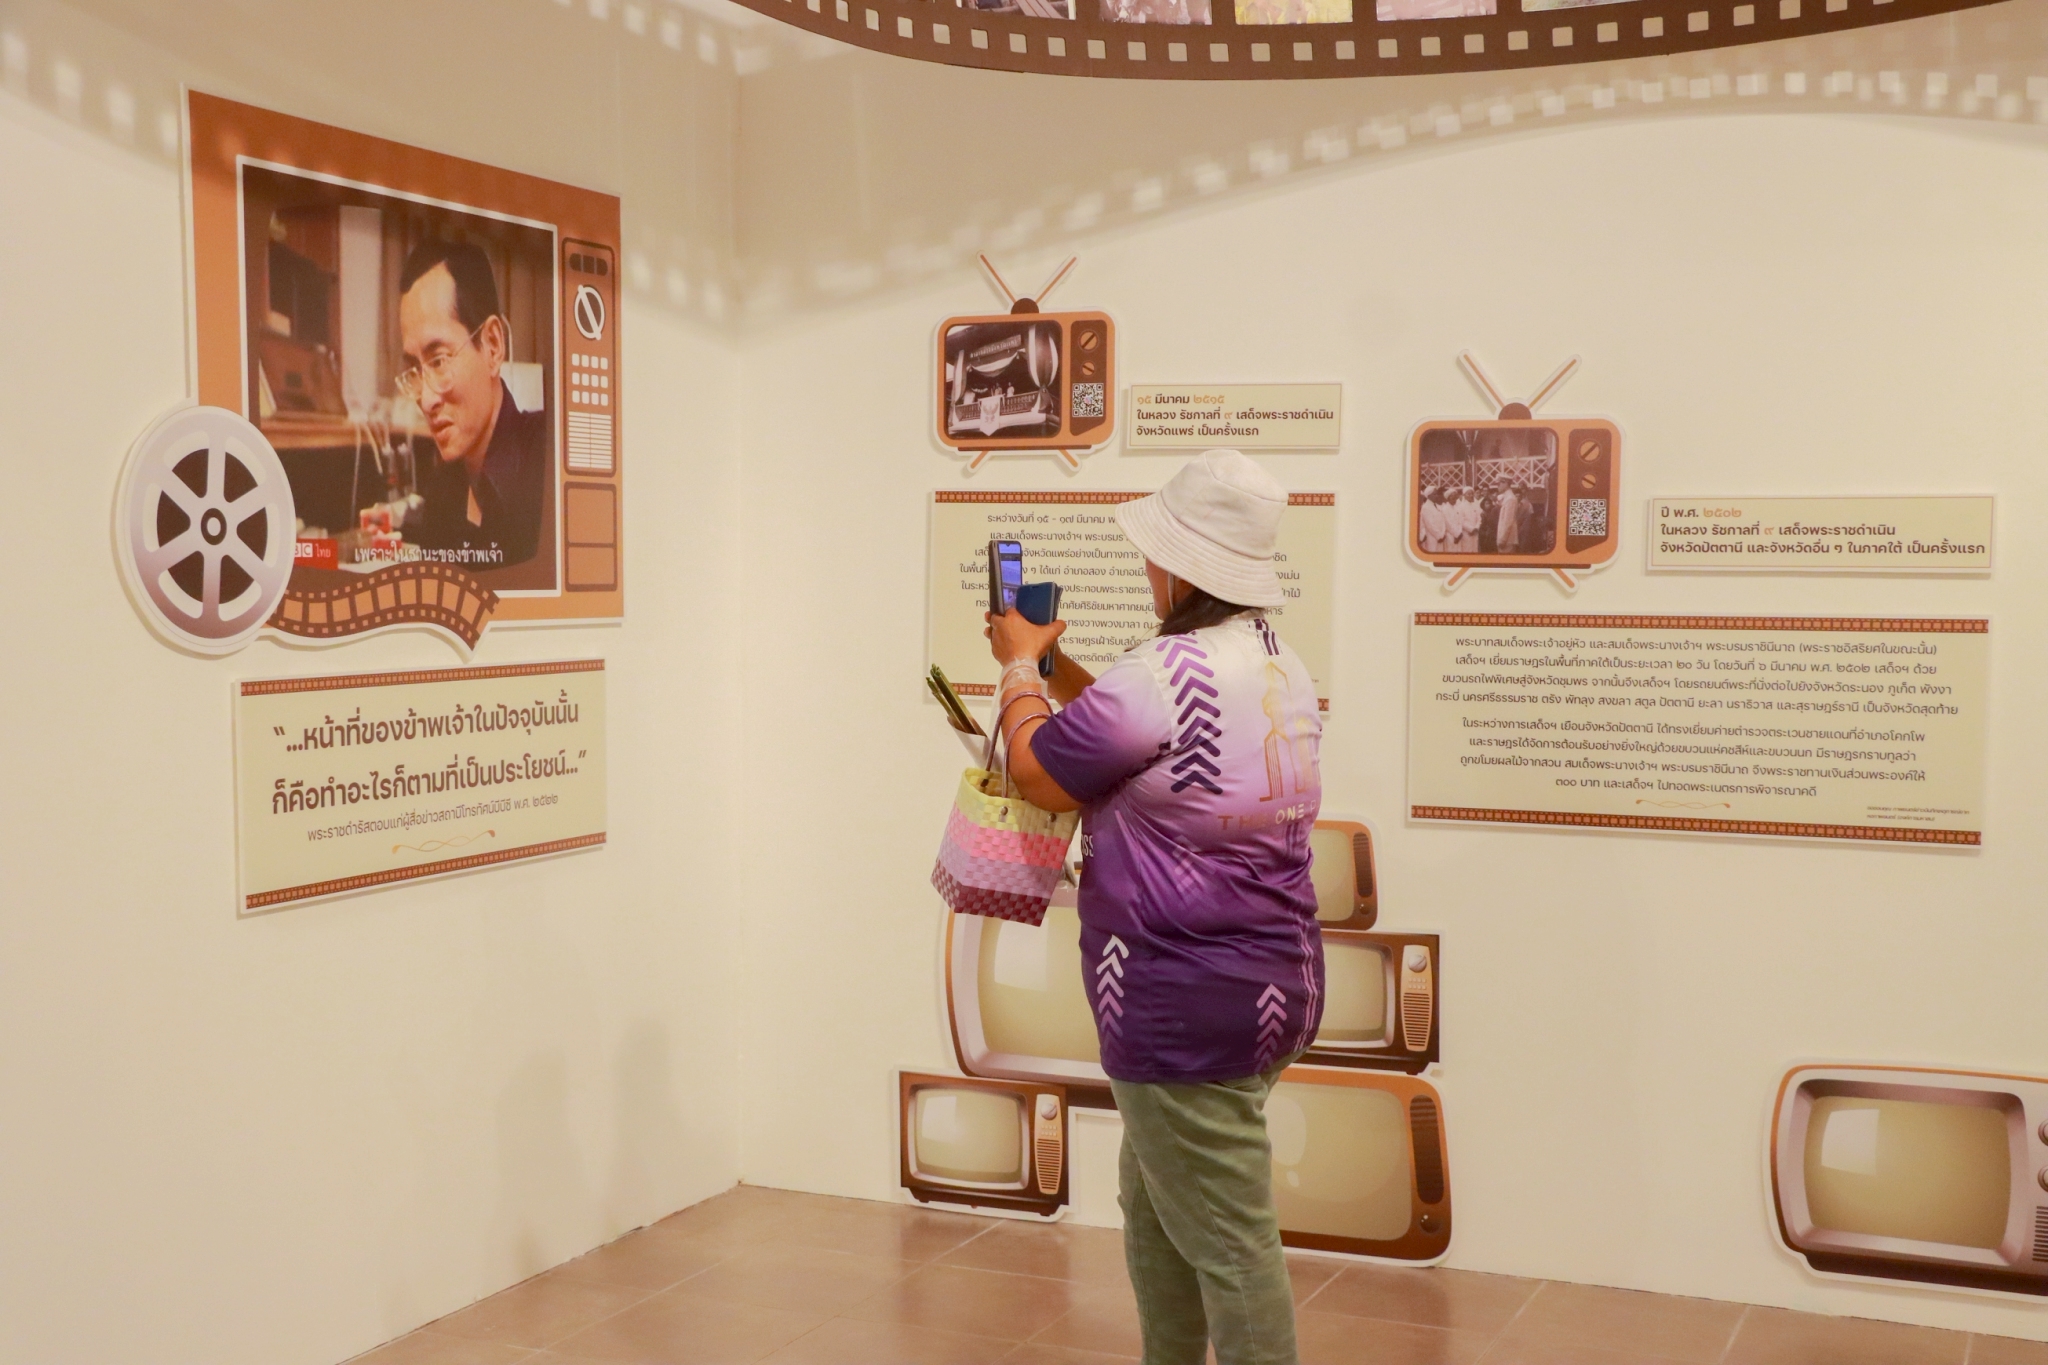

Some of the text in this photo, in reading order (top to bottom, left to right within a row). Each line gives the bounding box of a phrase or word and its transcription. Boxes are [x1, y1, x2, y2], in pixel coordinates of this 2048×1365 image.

[1155, 393, 1190, 405] มีนาคม
[1137, 408, 1177, 420] ในหลวง
[1180, 406, 1221, 420] รัชกาลที่
[1236, 407, 1334, 420] เสด็จพระราชดำเนิน
[1136, 421, 1259, 437] จังหวัดแพร่ เป็นครั้งแรก
[987, 511, 1034, 523] ระหว่างวันที่
[1076, 514, 1105, 524] มีนาคม
[1661, 506, 1742, 518] ปี พ.ศ. ๒๕๐๒
[990, 529, 1082, 541] และสมเด็จพระนางเจ้าฯ
[1661, 523, 1707, 536] ในหลวง
[1711, 521, 1760, 536] รัชกาลที่
[1778, 521, 1896, 536] เสด็จพระราชดำเนิน
[1660, 538, 1985, 555] จังหวัดปัตตานี และจังหวัดอื่น ๆ ในภาคใต้ เป็นครั้งแรก
[1039, 564, 1060, 575] ได้แก่
[1063, 565, 1106, 577] อำเภอสอง
[1455, 636, 1586, 652] พระบาทสมเด็จพระเจ้าอยู่หัว
[1589, 637, 1702, 651] และสมเด็จพระนางเจ้าฯ
[1706, 641, 1795, 653] พระบรมราชินีนาถ
[1455, 653, 1486, 666] เสด็จฯ
[1489, 652, 1673, 669] เยี่ยมราษฎรในพื้นที่ภาคใต้เป็นระยะเวลา
[1696, 659, 1710, 670] วัน
[1714, 658, 1755, 671] โดยวันที่
[1770, 661, 1806, 672] มีนาคม
[1810, 663, 1832, 673] พ.ศ.
[1874, 661, 1909, 674] เสด็จฯ
[1913, 663, 1937, 675] ด้วย
[1442, 673, 1952, 697] ขบวนรถไฟพิเศษสู่จังหวัดชุมพร จากนั้นจึงเสด็จฯ โดยรถยนต์พระที่นั่งต่อไปยังจังหวัดระนอง ภูเก็ต พังงา
[1435, 689, 1959, 717] กระบี่ นครศรีธรรมราช ตรัง พัทลุง สงขลา สตูล ปัตตานี ยะลา นราธิวาส และสุราษฎร์ธานี เป็นจังหวัดสุดท้าย
[1462, 717, 1557, 730] ในระหว่างการเสด็จฯ
[1561, 719, 1653, 733] เยือนจังหวัดปัตตานี
[1816, 748, 1916, 763] มีราษฎรกราบทูลว่า
[1460, 755, 1926, 781] ถูกขโมยผลไม้จากสวน สมเด็จพระนางเจ้าฯ พระบรมราชินีนาถ จึงพระราชทานเงินส่วนพระองค์ให้
[1580, 778, 1600, 788] บาท
[1604, 777, 1653, 790] และเสด็จฯ
[1657, 780, 1817, 797] ไปทอดพระเนตรการพิจารณาคดี
[513, 798, 530, 810] พ.ศ.
[1275, 803, 1304, 825] ONE
